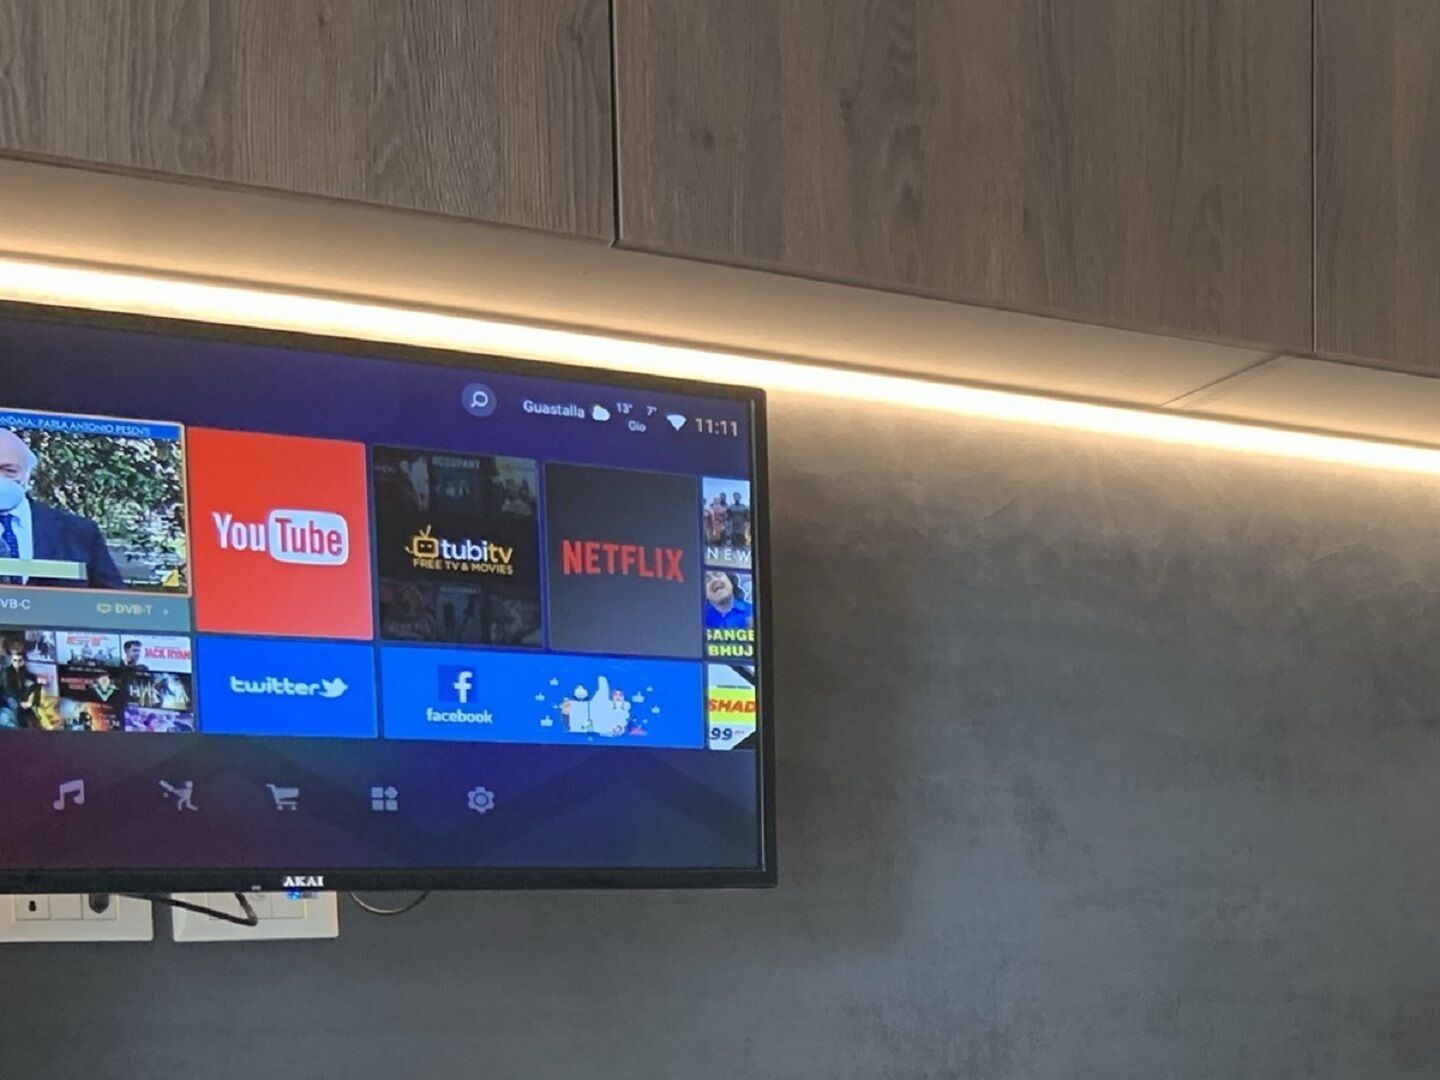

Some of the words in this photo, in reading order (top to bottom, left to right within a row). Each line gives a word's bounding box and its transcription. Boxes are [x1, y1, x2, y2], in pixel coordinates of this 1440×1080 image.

[522, 399, 586, 419] Guastalla
[628, 420, 647, 433] Gio
[695, 417, 739, 437] 11:11
[211, 511, 343, 556] YouTube
[440, 539, 513, 564] tubitv
[413, 558, 443, 570] FREE
[445, 561, 460, 571] TV
[461, 563, 469, 572] &
[471, 562, 514, 575] MOVIES
[562, 540, 684, 583] NETFLIX
[115, 603, 153, 615] DVB-T
[144, 648, 166, 659] JACK
[708, 645, 753, 657] BHUJ
[229, 676, 321, 696] twitter
[426, 707, 493, 724] facebook
[283, 876, 324, 887] AKAI
